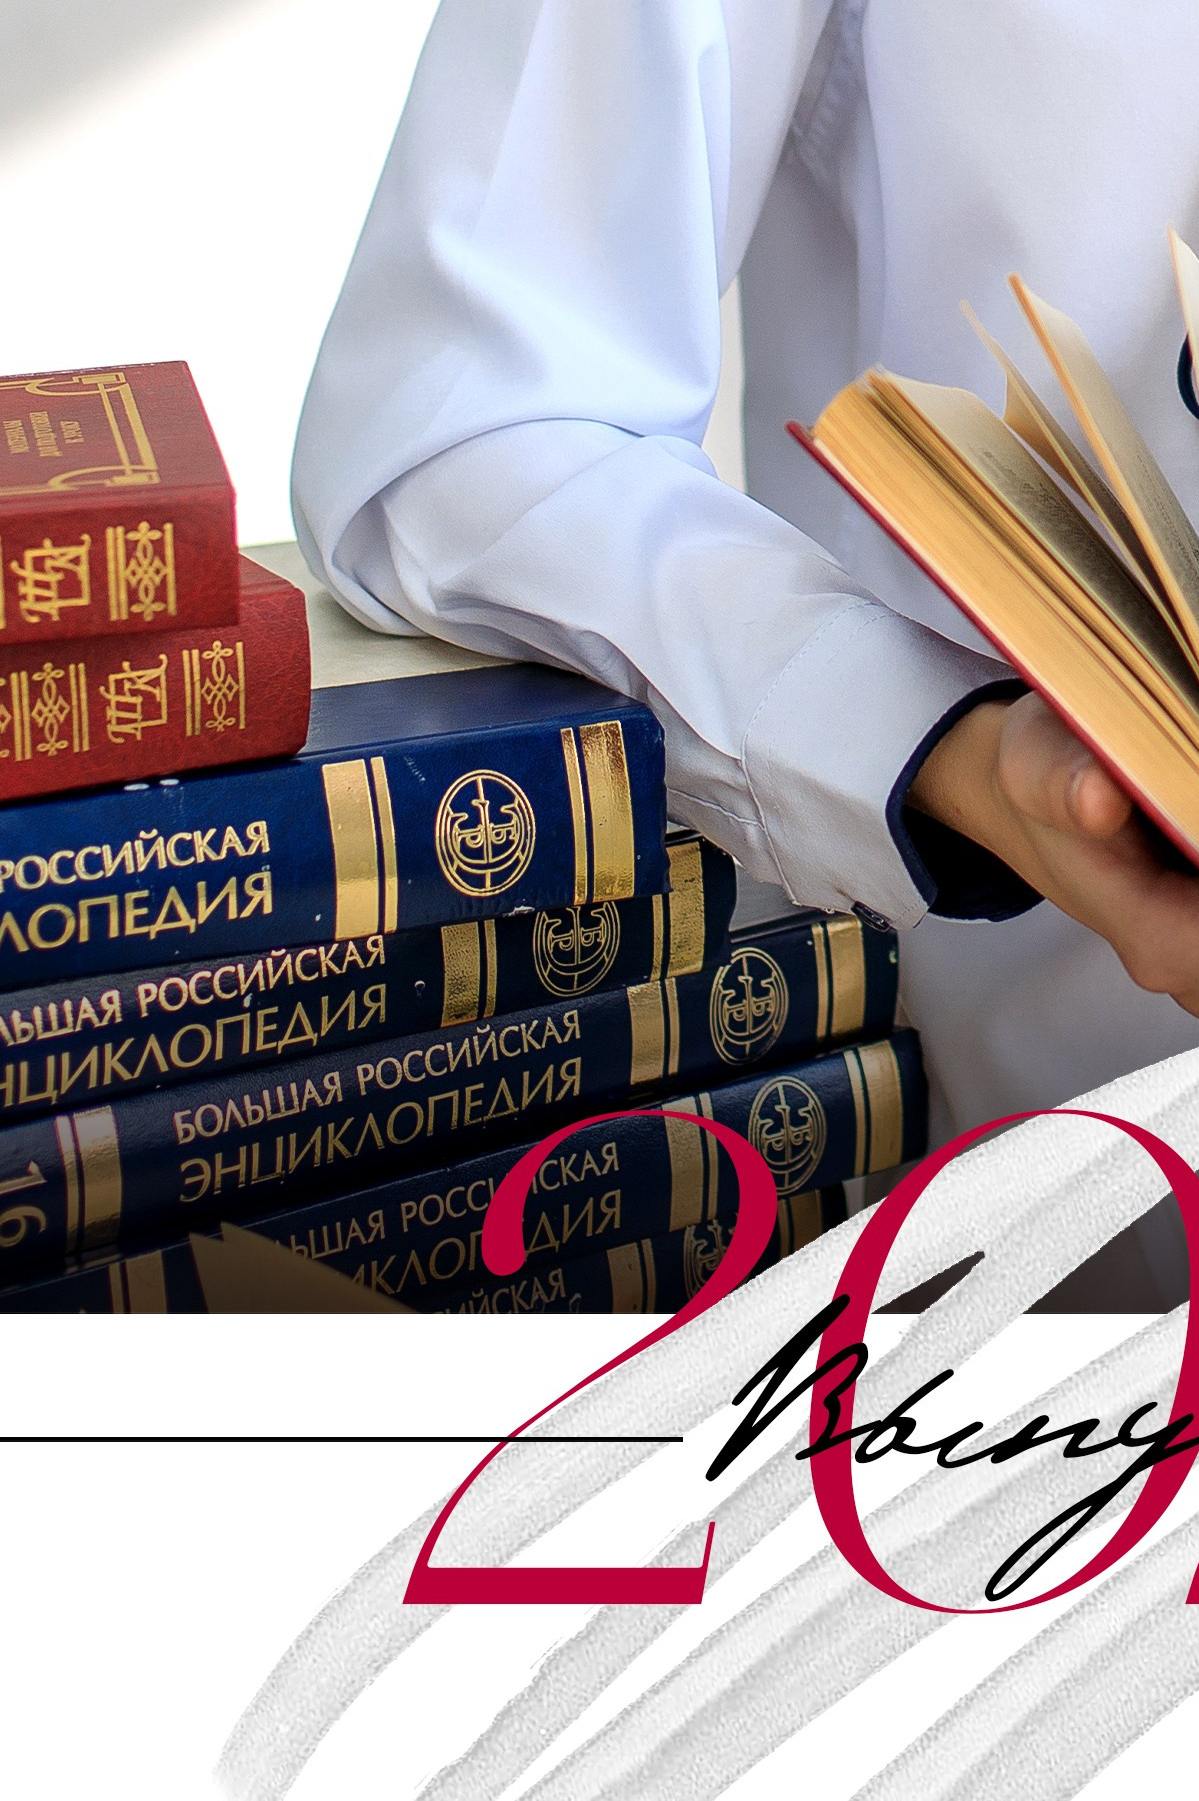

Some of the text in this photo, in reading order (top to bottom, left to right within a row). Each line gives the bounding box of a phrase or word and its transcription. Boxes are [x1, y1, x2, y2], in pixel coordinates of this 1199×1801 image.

[0, 820, 270, 894] РОССИЙСКАЯ
[0, 870, 273, 952] ЛОПЕДИЯ
[137, 934, 386, 1017] РОССИЙСКАЯ
[174, 1008, 582, 1145] БОЛЬШАЯ РОССИЙСКАЯ
[178, 1056, 583, 1203] ЭНЦИКЛОПЕДИЯ
[0, 1160, 48, 1248] 16
[274, 1142, 621, 1260] ЬШАЯ РОСССКАЯ
[351, 1189, 623, 1296] КЛОДИЯ
